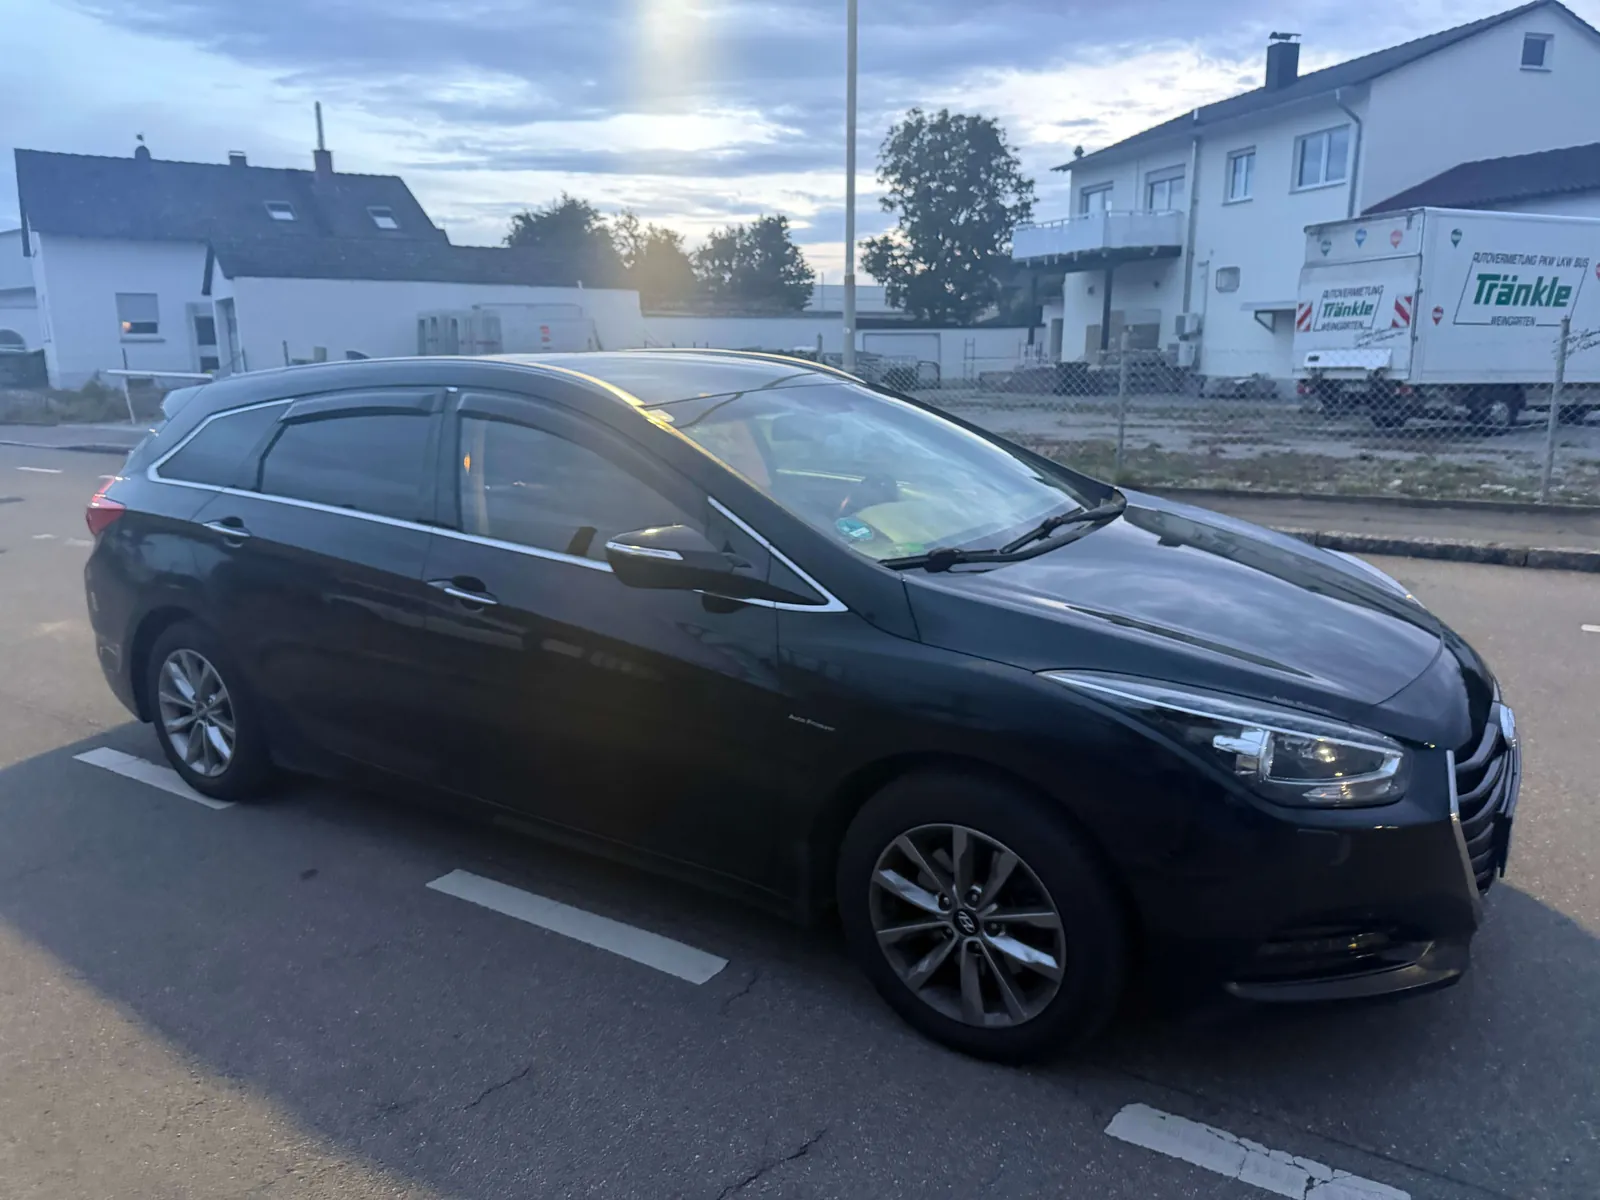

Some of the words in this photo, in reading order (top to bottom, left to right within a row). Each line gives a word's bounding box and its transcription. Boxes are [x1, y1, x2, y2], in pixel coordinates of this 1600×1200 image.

[1472, 252, 1538, 266] AUTOVERMIETUNG
[1538, 255, 1556, 266] PKW
[1556, 256, 1572, 267] LKW
[1573, 257, 1590, 268] BUS
[1473, 273, 1573, 308] Tränkle
[1322, 300, 1374, 318] Tränkle
[1490, 316, 1536, 327] WEINGARTEN
